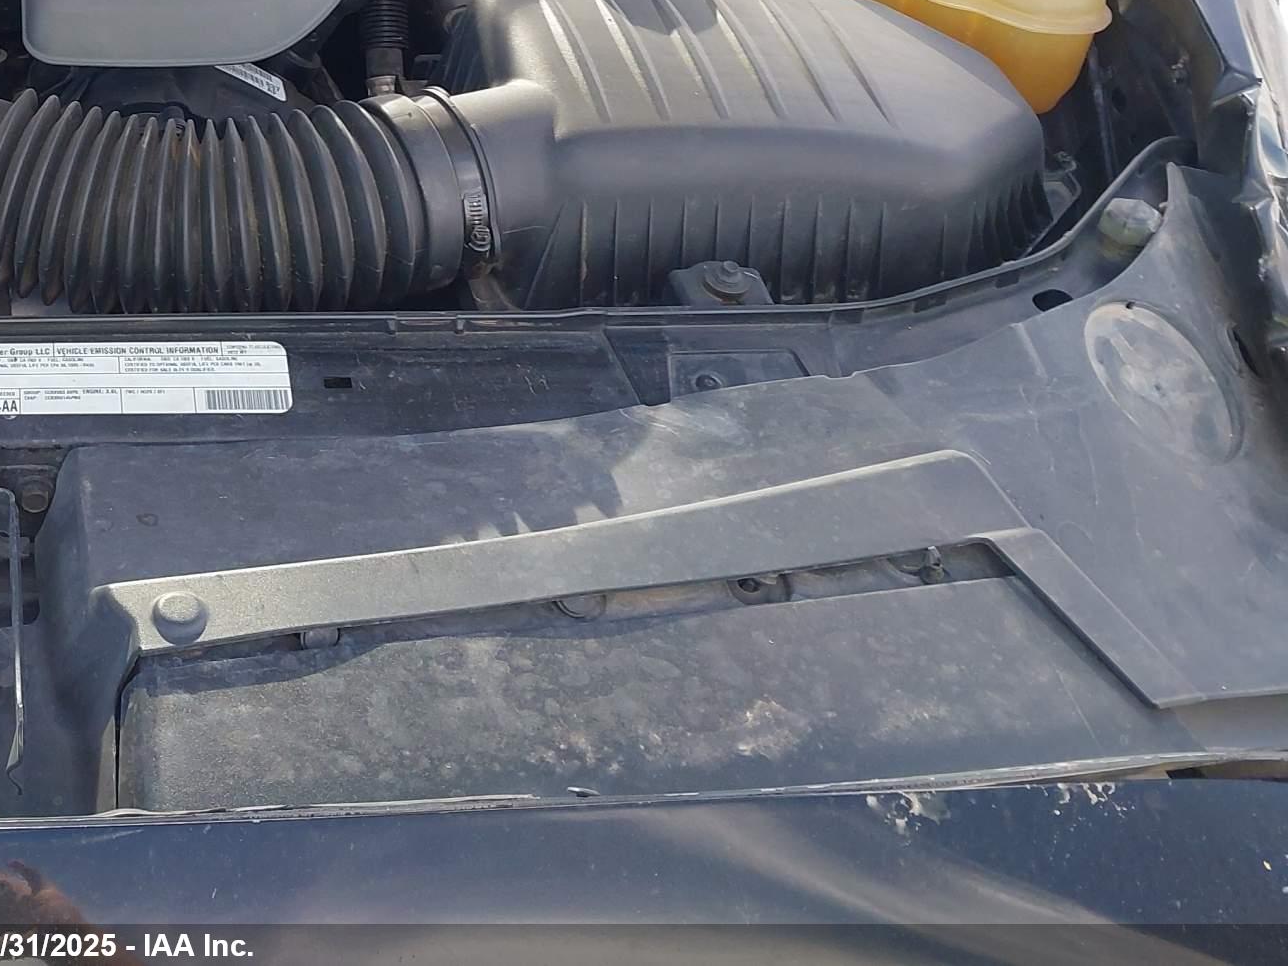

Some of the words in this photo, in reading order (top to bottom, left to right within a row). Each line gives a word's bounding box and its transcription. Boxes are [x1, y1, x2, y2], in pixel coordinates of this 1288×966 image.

[9, 348, 33, 356] Group
[56, 347, 88, 355] VEHICLE
[90, 347, 127, 355] EMISSION
[129, 346, 164, 354] CONTROL
[166, 346, 219, 354] INFORMATION
